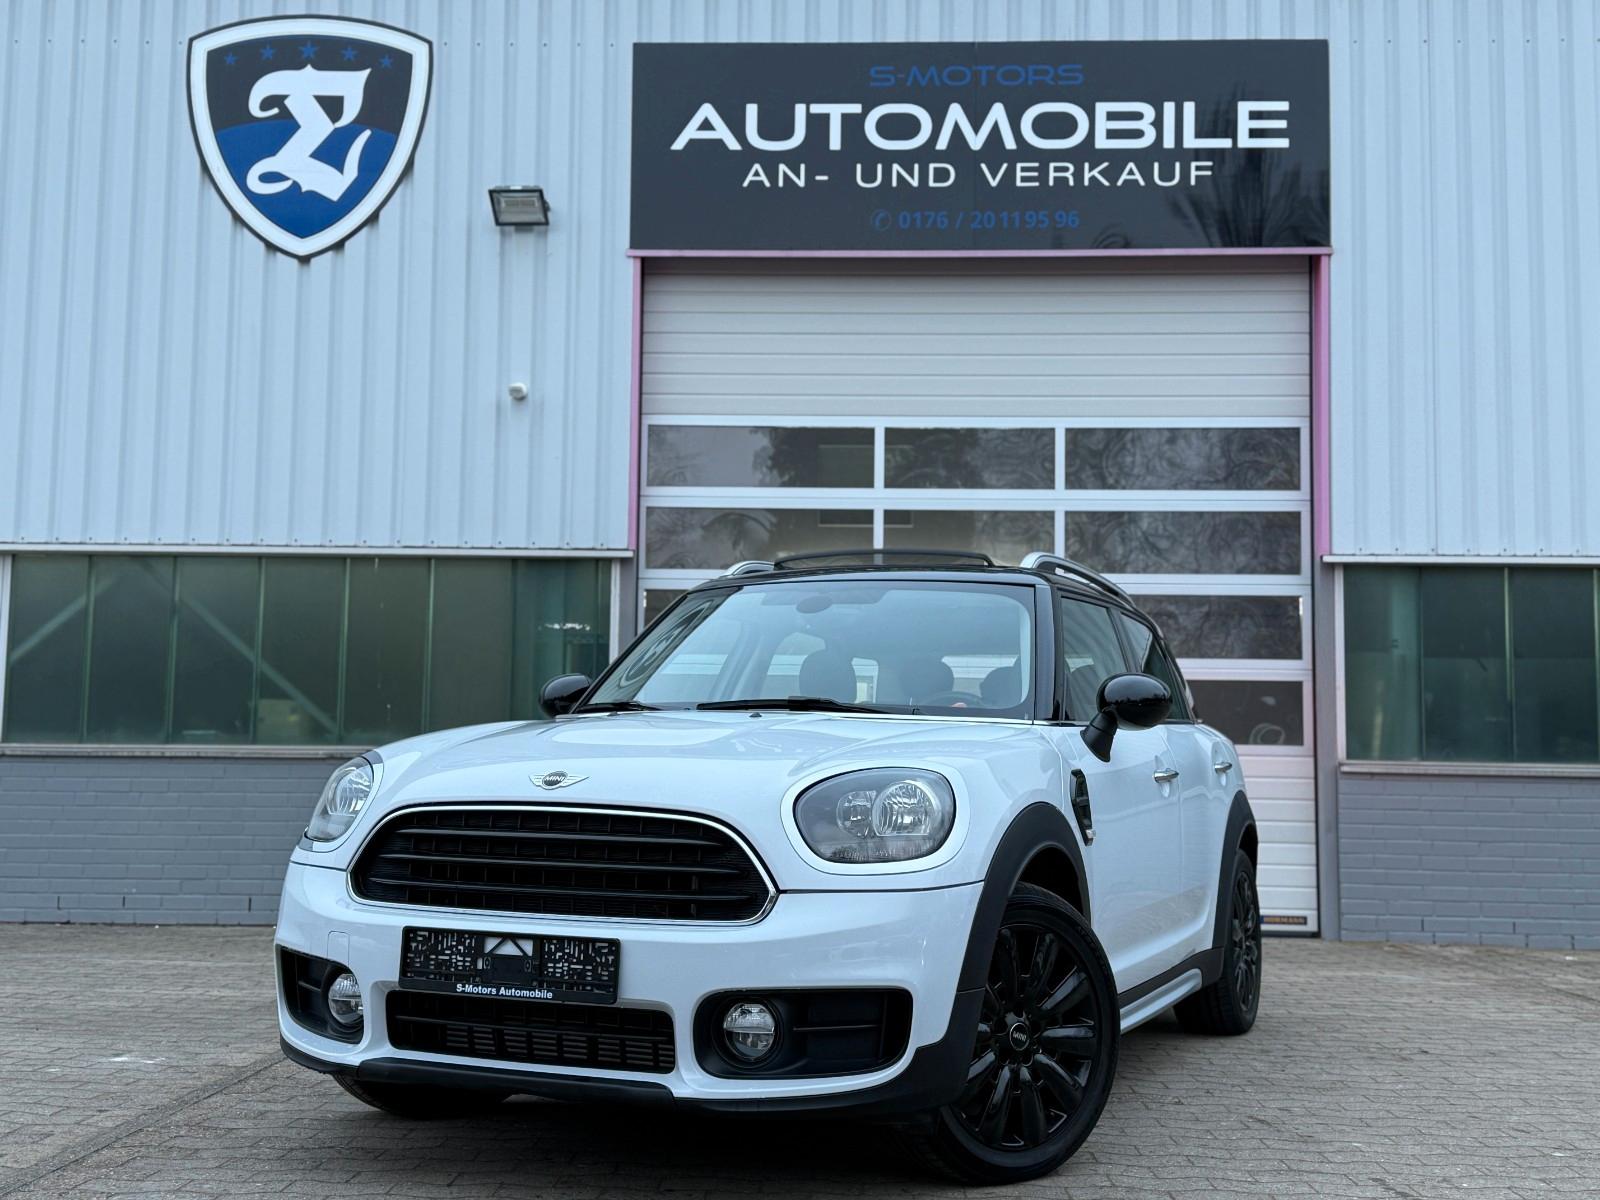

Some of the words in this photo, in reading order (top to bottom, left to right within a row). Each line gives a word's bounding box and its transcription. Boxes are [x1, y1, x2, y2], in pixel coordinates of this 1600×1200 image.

[868, 64, 1084, 87] S-MOTORS
[670, 101, 1291, 151] AUTOMOBILE
[742, 163, 829, 188] AN-
[855, 162, 956, 188] UND
[980, 161, 1214, 188] VERKAUF
[897, 210, 949, 230] 0176
[456, 983, 497, 995] S-Motors
[498, 986, 553, 999] Automobile
